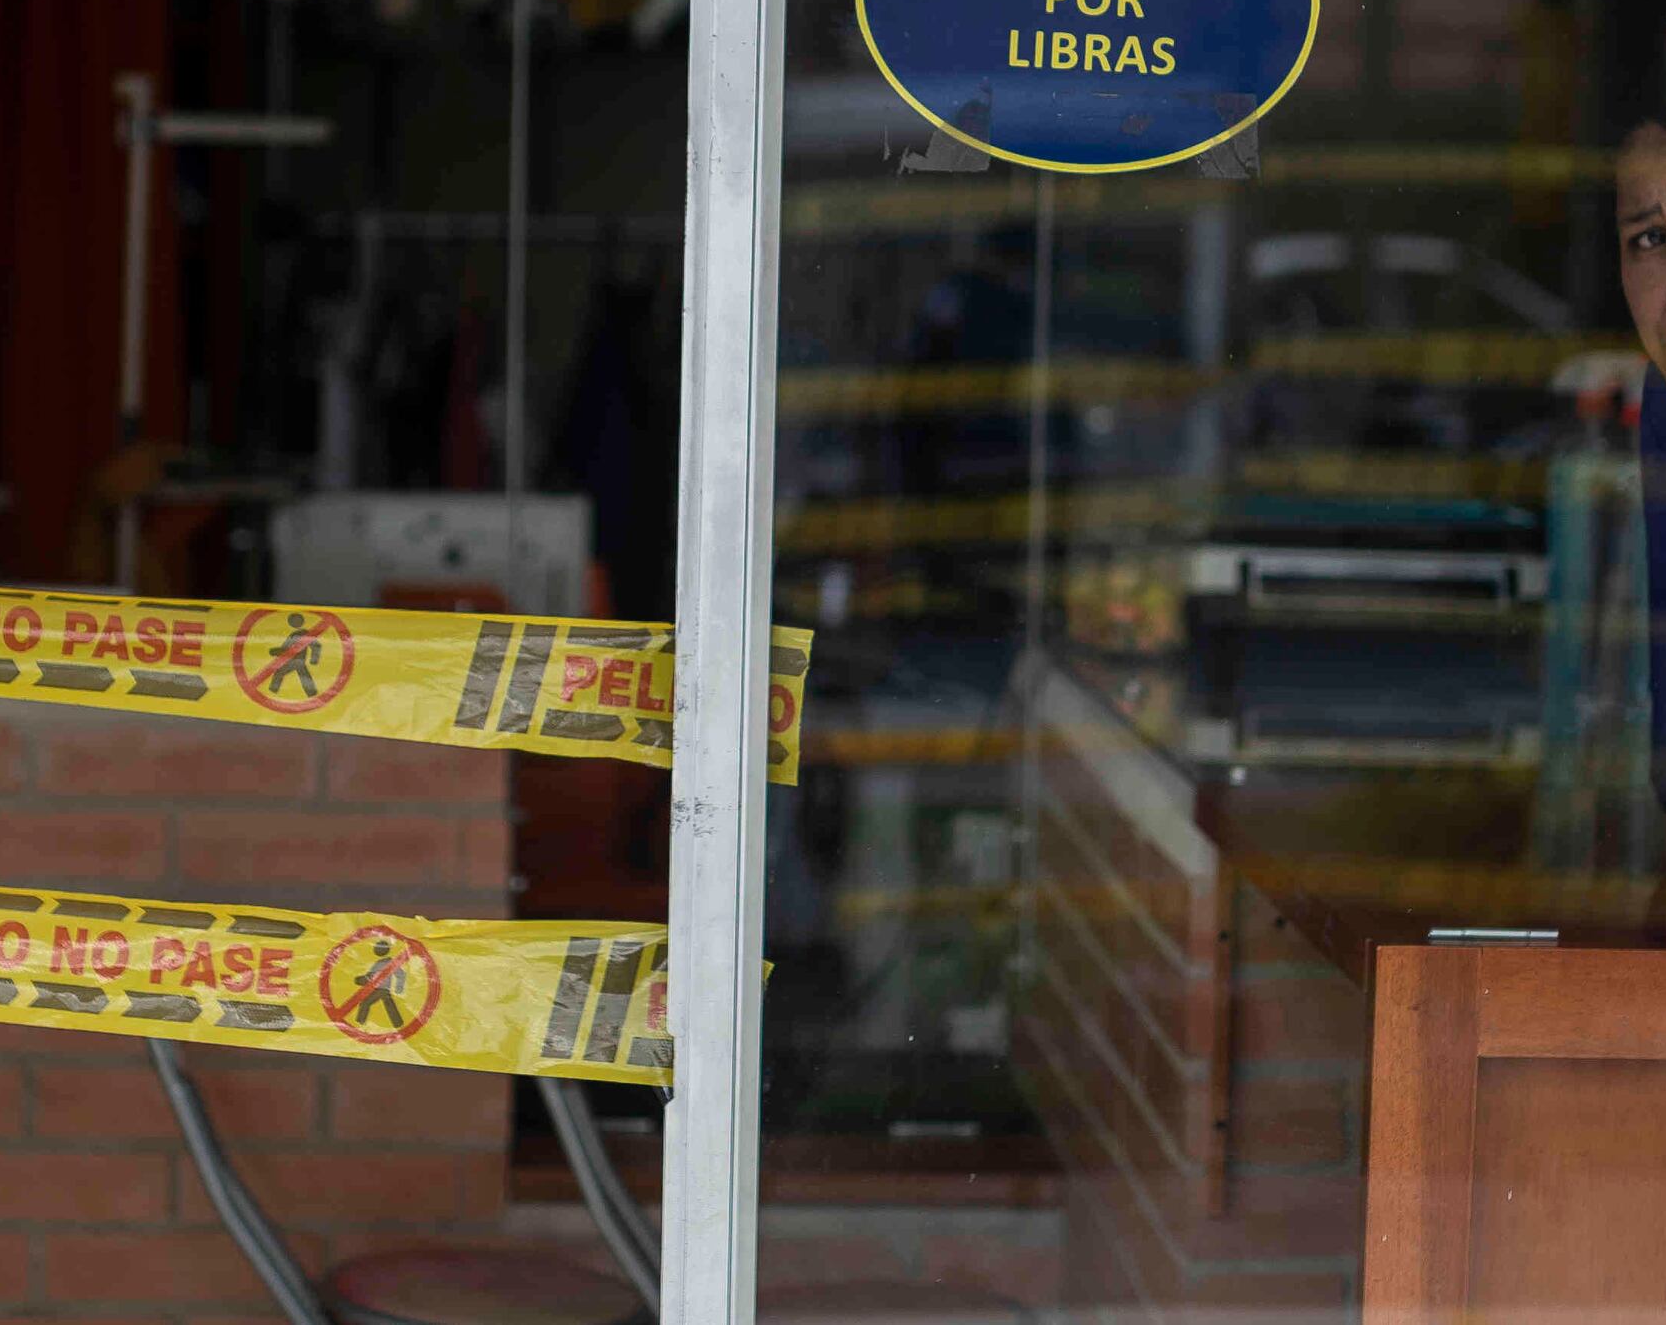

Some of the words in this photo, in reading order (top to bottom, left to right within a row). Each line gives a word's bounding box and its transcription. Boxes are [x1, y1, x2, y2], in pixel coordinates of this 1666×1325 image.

[1009, 30, 1175, 75] LIBRAS
[62, 610, 205, 667] PASE
[50, 925, 129, 979] NO
[149, 937, 294, 995] PASE
